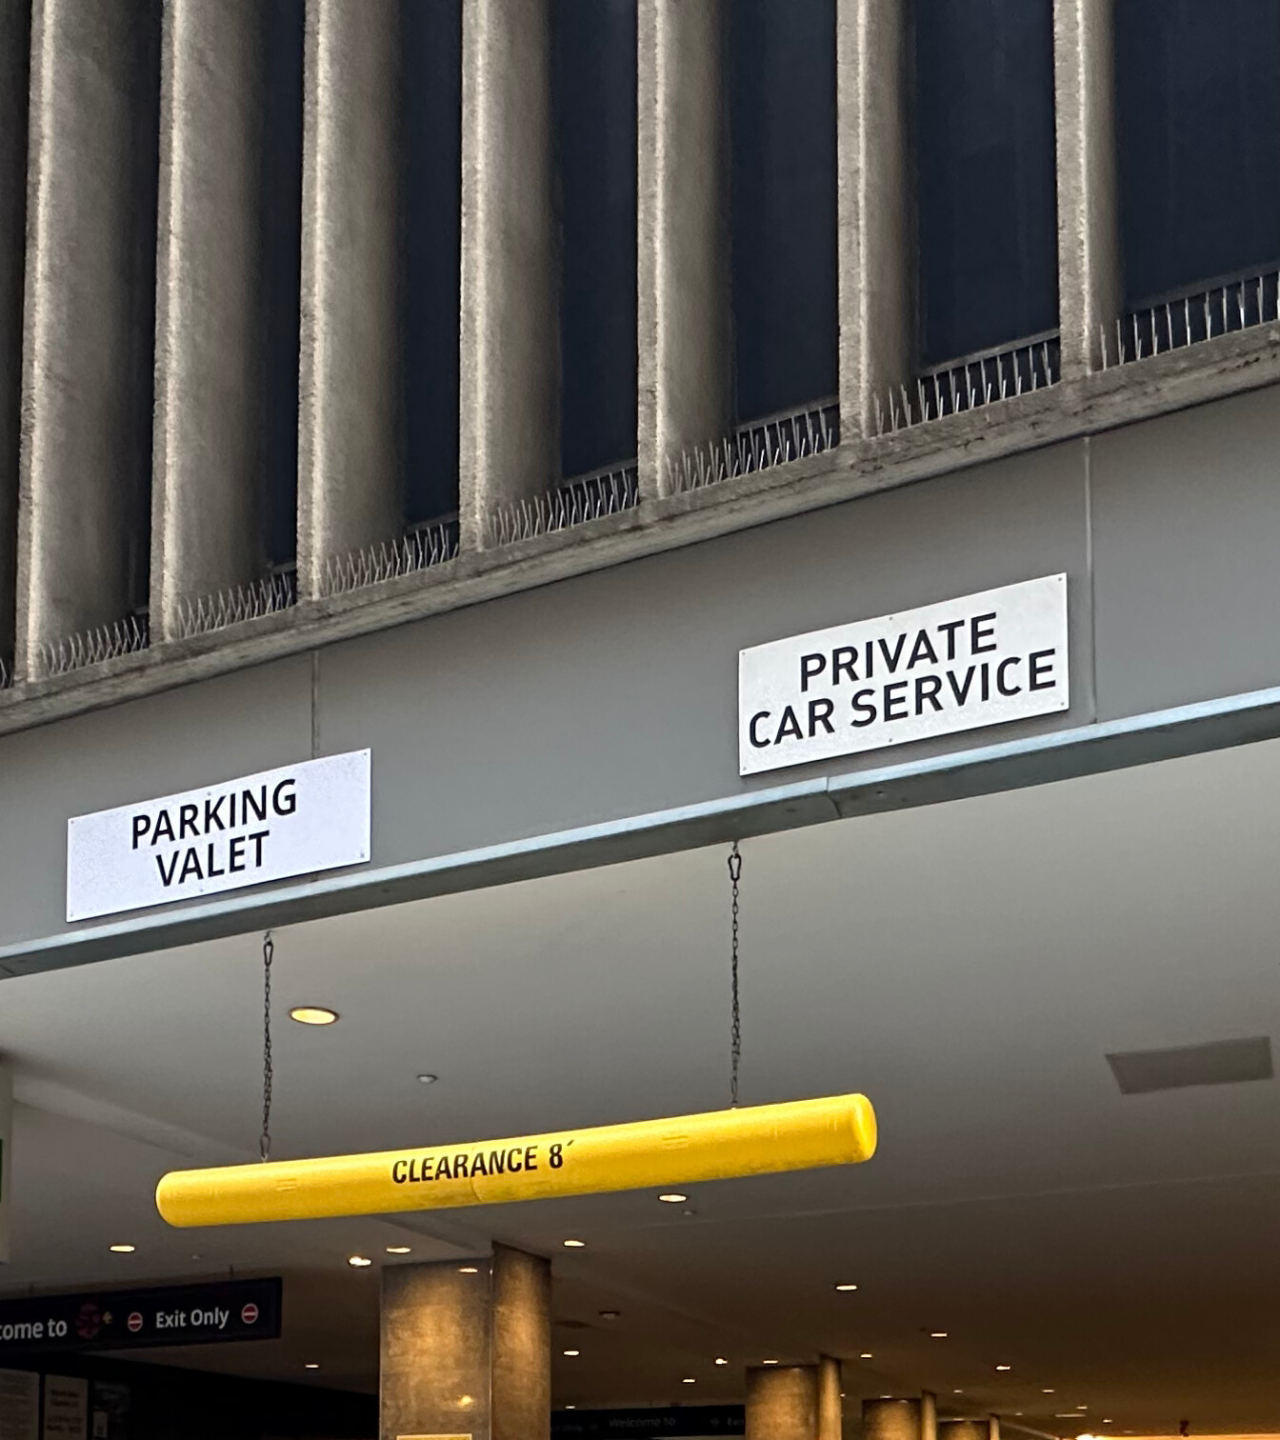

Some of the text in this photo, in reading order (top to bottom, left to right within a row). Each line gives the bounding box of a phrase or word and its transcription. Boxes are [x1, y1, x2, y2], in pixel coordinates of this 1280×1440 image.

[798, 611, 999, 694] PRIVATE
[747, 647, 1058, 750] CAR SERVICE
[129, 777, 299, 850] PARKING
[155, 829, 271, 889] VALET
[392, 1145, 538, 1184] CLEARANCE
[48, 1318, 68, 1338] to
[155, 1306, 230, 1330] Exit Only
